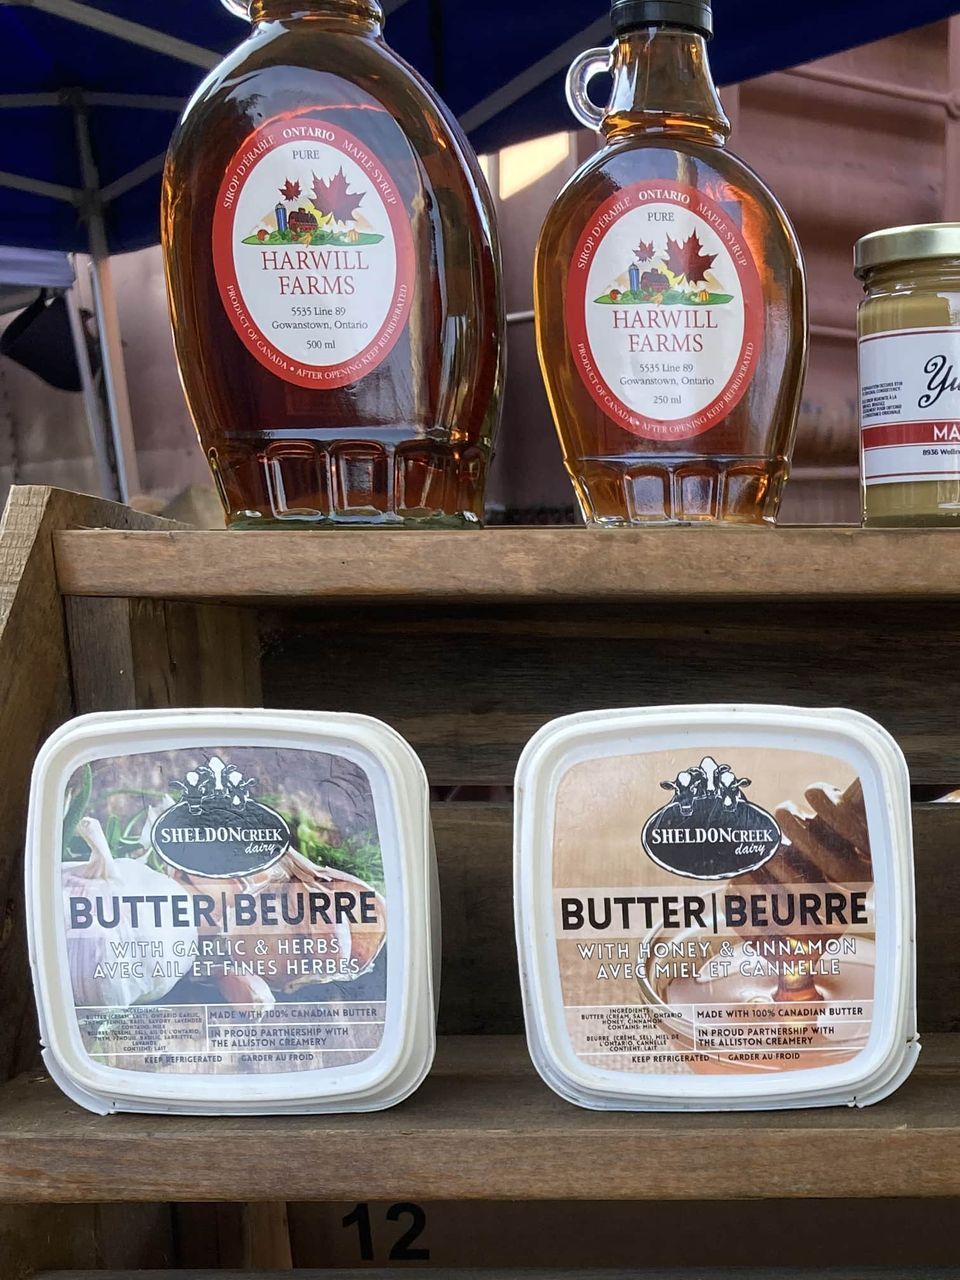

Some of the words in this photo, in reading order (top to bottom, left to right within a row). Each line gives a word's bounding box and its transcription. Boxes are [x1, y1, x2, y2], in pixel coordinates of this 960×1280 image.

[292, 149, 320, 160] PURE
[223, 176, 242, 209] SIROP
[283, 126, 335, 142] ONTARIO
[342, 139, 373, 171] MAPLE
[371, 168, 398, 205] SYRUP
[648, 212, 674, 222] PURE
[578, 239, 595, 269] SIROP
[639, 190, 690, 204] ONTARIO
[696, 203, 728, 234] MAPLE
[726, 233, 748, 267] SYRUP
[262, 251, 369, 270] HARWILL
[279, 276, 355, 295] FARMS
[291, 307, 312, 316] 5535
[314, 307, 332, 316] Line
[335, 307, 346, 316] 89
[271, 319, 332, 331] Gowanstown,
[334, 320, 368, 329] Ontario
[613, 311, 718, 329] HARWILL
[227, 285, 252, 332] PRODUCT
[256, 339, 288, 369] CANADA
[296, 368, 322, 379] AFTER
[324, 363, 362, 379] OPENING
[361, 345, 380, 364] KEEP
[306, 340, 322, 349] 500
[324, 340, 335, 349] ml
[628, 334, 704, 352] FARMS
[639, 363, 659, 373] 5535
[662, 363, 680, 373] Line
[682, 363, 693, 373] 89
[619, 376, 678, 387] Gowanstown,
[681, 376, 714, 386] Ontario
[653, 395, 668, 405] 250
[671, 395, 682, 404] ml
[245, 843, 275, 855] dairy
[735, 843, 765, 855] dairy
[110, 942, 163, 958] WITH
[174, 940, 246, 956] GARLIC
[255, 939, 268, 953] &
[278, 938, 339, 953] HERBS
[577, 943, 629, 959] WITH
[640, 942, 710, 958] HONEY
[720, 942, 734, 955] &
[744, 939, 856, 955] CINNAMON
[94, 962, 144, 978] AVEC
[153, 961, 183, 977] AIL
[193, 961, 215, 976] ET
[224, 960, 277, 975] FINES
[287, 958, 360, 973] HERBES
[597, 964, 646, 979] AVEC
[656, 963, 700, 978] MIEL
[710, 962, 730, 976] ET
[740, 960, 840, 976] CANNELLE
[697, 1010, 723, 1018] MADE
[726, 1010, 749, 1018] WITH
[752, 1009, 775, 1017] 100%
[778, 1008, 827, 1017] CANADIAN
[829, 1007, 863, 1016] BUTTER
[699, 1029, 707, 1037] IN
[711, 1028, 743, 1036] PROUD
[748, 1027, 807, 1036] PARTNERSHIP
[811, 1026, 834, 1034] WITH
[718, 1038, 762, 1046] ALLISTON
[766, 1037, 813, 1045] CREAMERY
[653, 1054, 710, 1063] REFRIGERATED
[341, 1202, 430, 1261] 12
